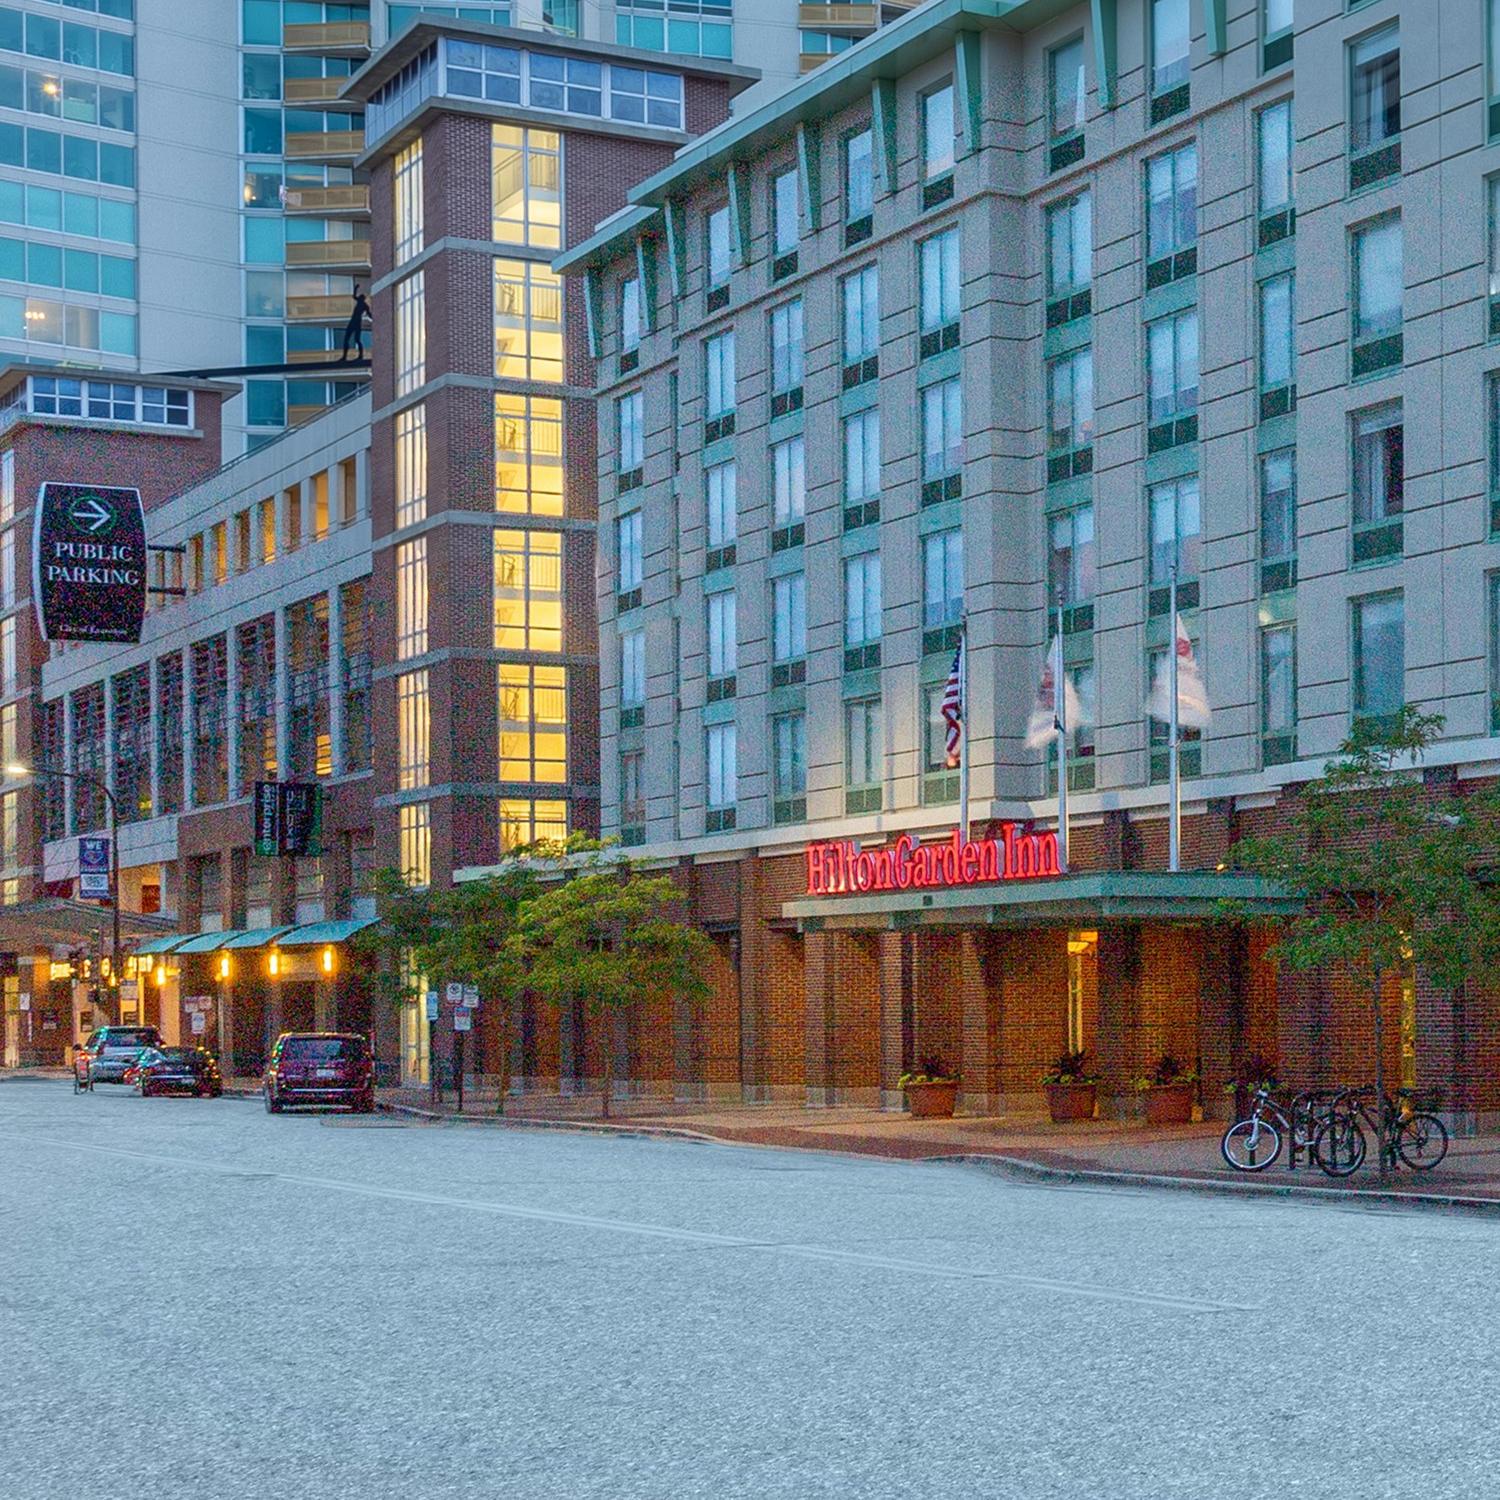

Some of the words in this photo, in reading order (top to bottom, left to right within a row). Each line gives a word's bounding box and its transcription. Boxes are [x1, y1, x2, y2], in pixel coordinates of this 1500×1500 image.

[54, 541, 134, 562] PUBLIC
[47, 564, 140, 586] PARKING
[260, 783, 273, 852] enterprise
[85, 840, 103, 850] WE
[806, 841, 894, 895] Hilton
[894, 829, 1000, 889] Garden
[1002, 822, 1061, 879] Inn
